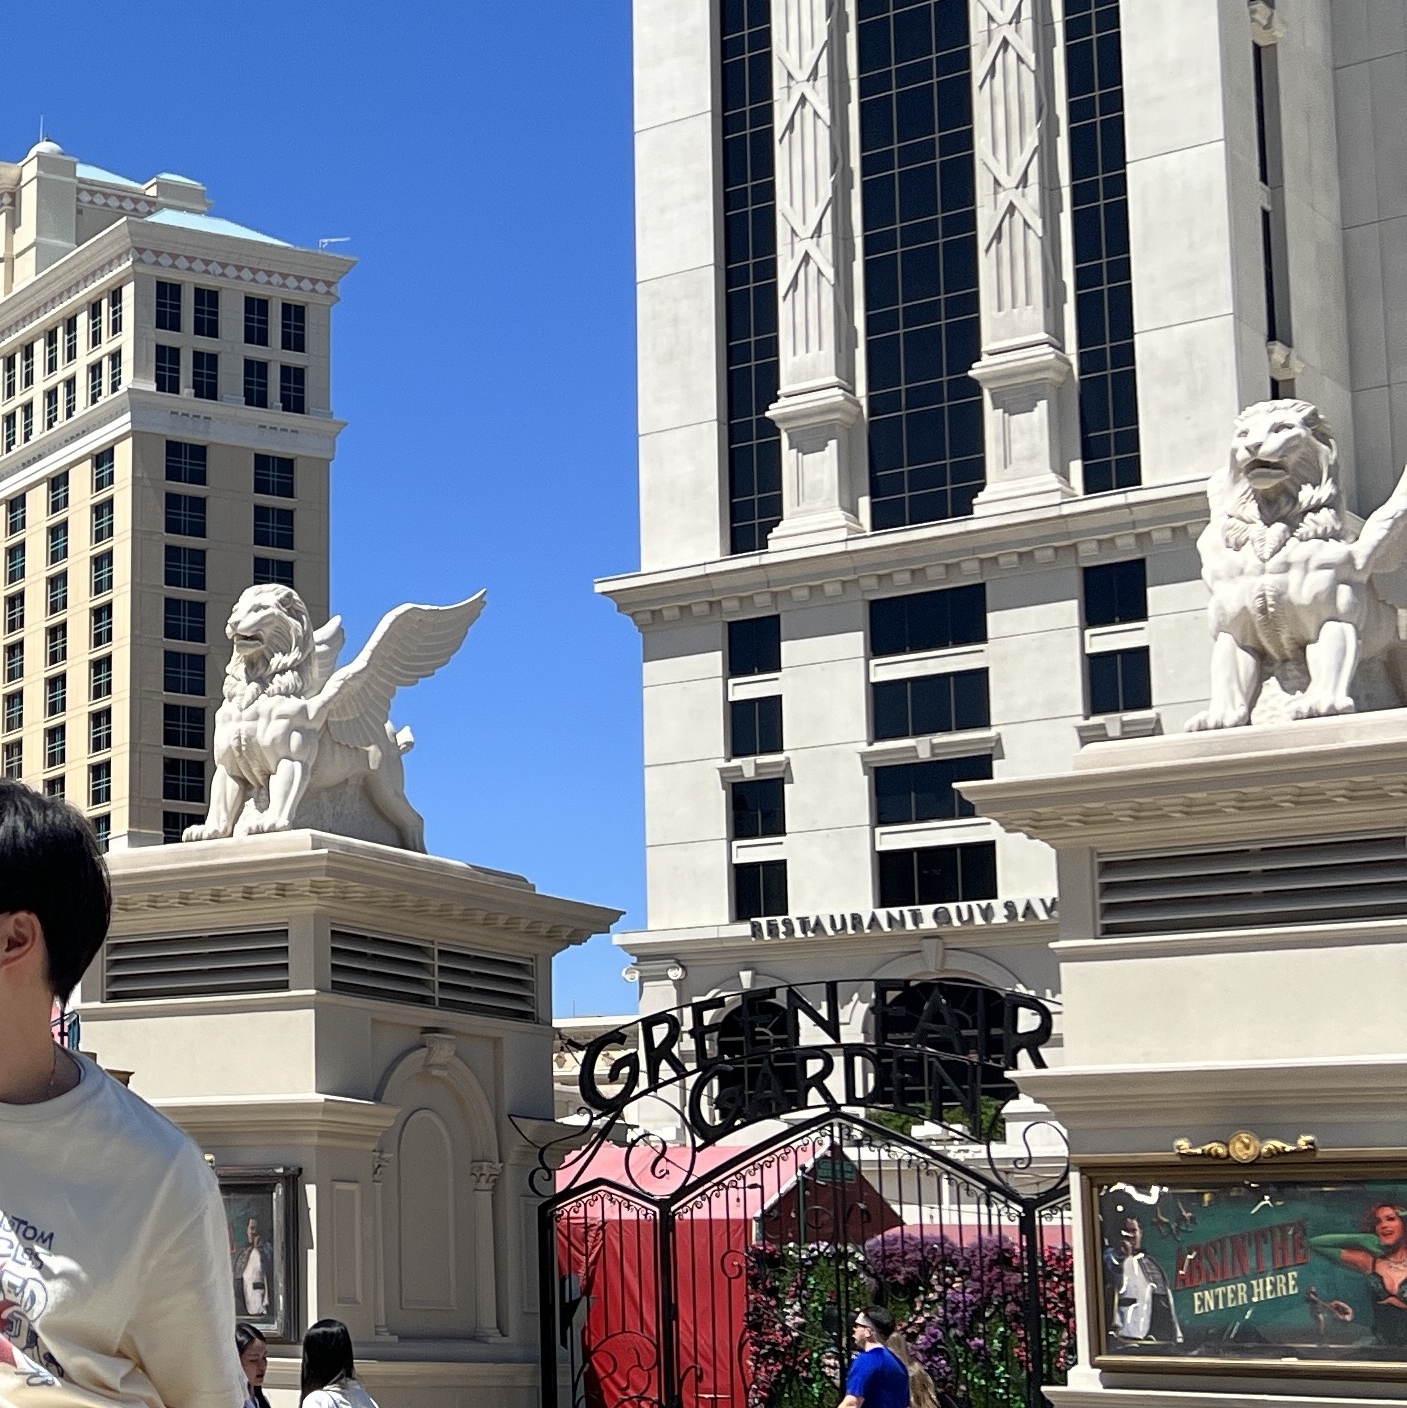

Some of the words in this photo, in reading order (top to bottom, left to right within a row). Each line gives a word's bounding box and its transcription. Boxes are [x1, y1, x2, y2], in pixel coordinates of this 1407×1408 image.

[750, 907, 923, 941] RESTAURANT
[932, 901, 994, 926] GUY
[579, 981, 841, 1112] GREEN
[872, 978, 1053, 1070] FAIR
[690, 1046, 984, 1142] GARDEN
[1174, 1217, 1311, 1291] ABSINTHE
[1193, 1283, 1248, 1315] ENTER
[1250, 1271, 1299, 1303] HERE
